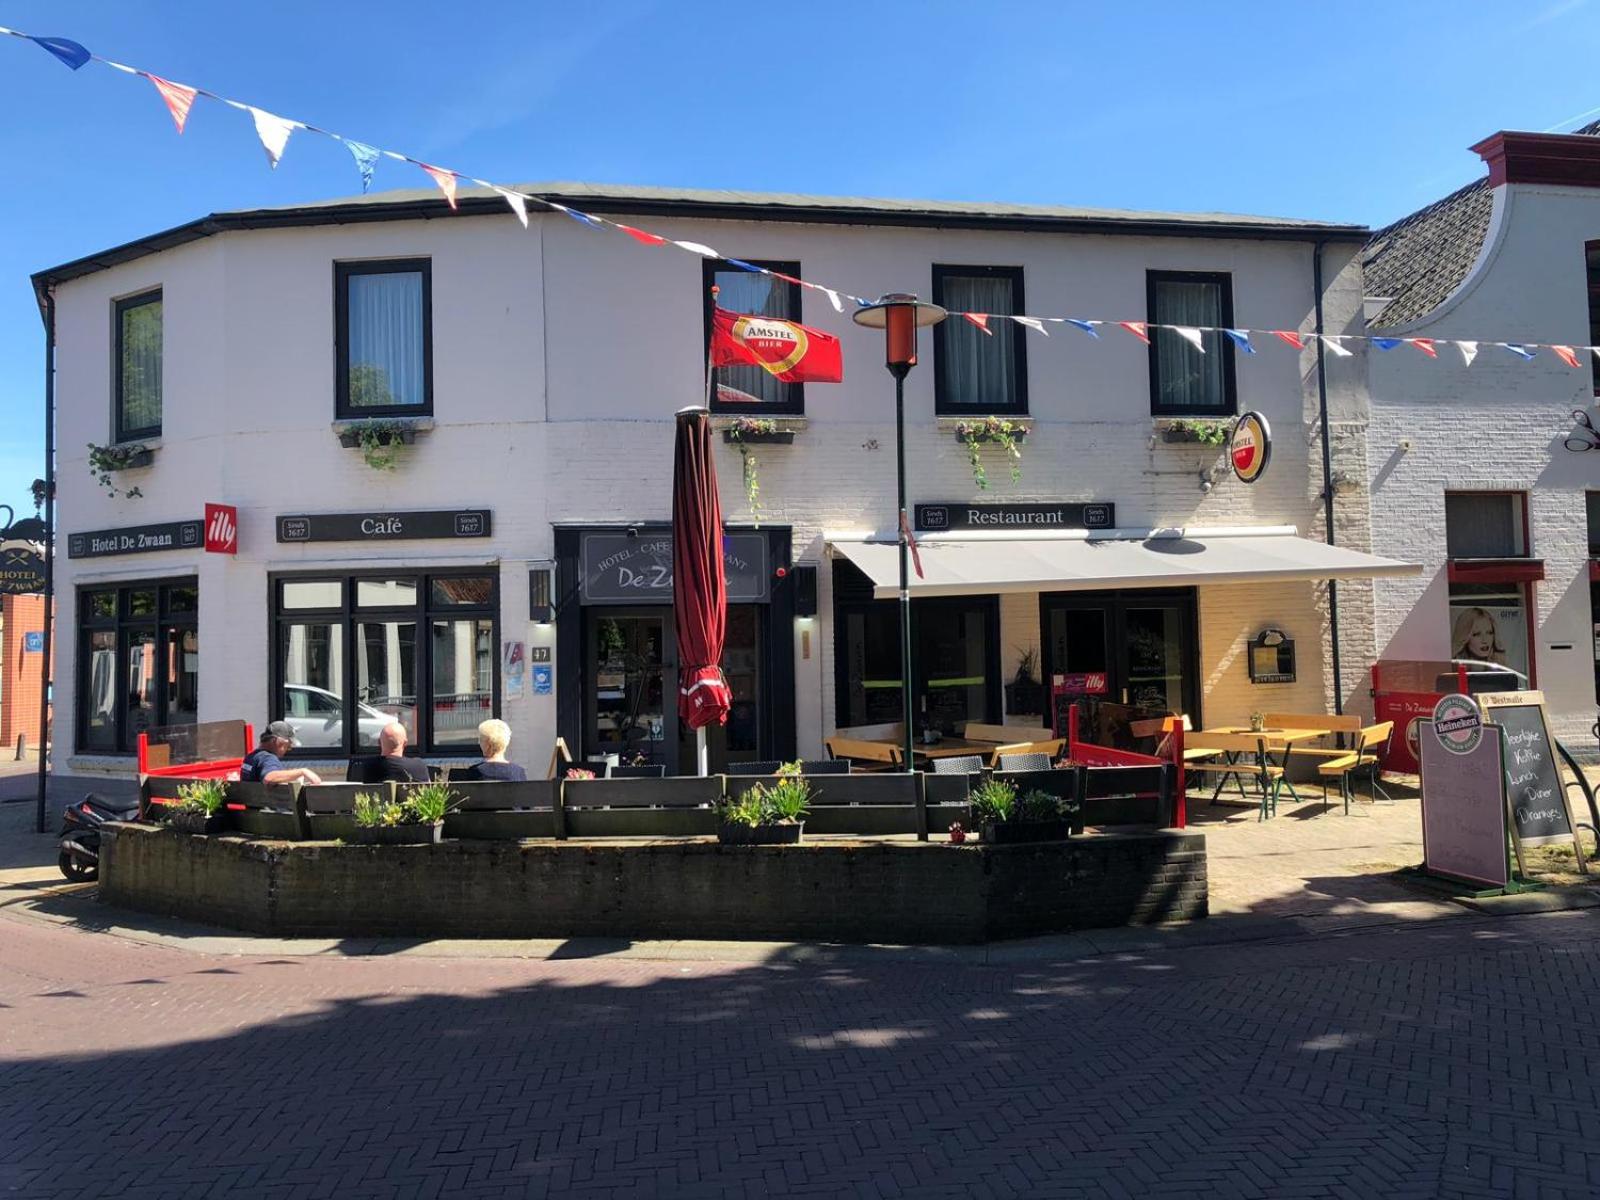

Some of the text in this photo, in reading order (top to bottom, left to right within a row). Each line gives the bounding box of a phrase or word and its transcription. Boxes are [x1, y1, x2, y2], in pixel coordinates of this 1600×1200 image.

[748, 327, 793, 339] AMSTEL
[758, 340, 783, 348] BIER
[967, 509, 1064, 524] Restaurant
[208, 511, 236, 549] illy
[361, 517, 402, 534] Café
[92, 538, 118, 552] Hotel
[121, 536, 135, 549] De
[138, 534, 172, 547] Zwaan
[598, 549, 632, 571] HOTEL
[618, 567, 645, 587] De
[1086, 676, 1104, 690] illy
[1437, 718, 1478, 732] Heineken
[1507, 770, 1539, 785] Lunch
[1524, 786, 1552, 800] Diner
